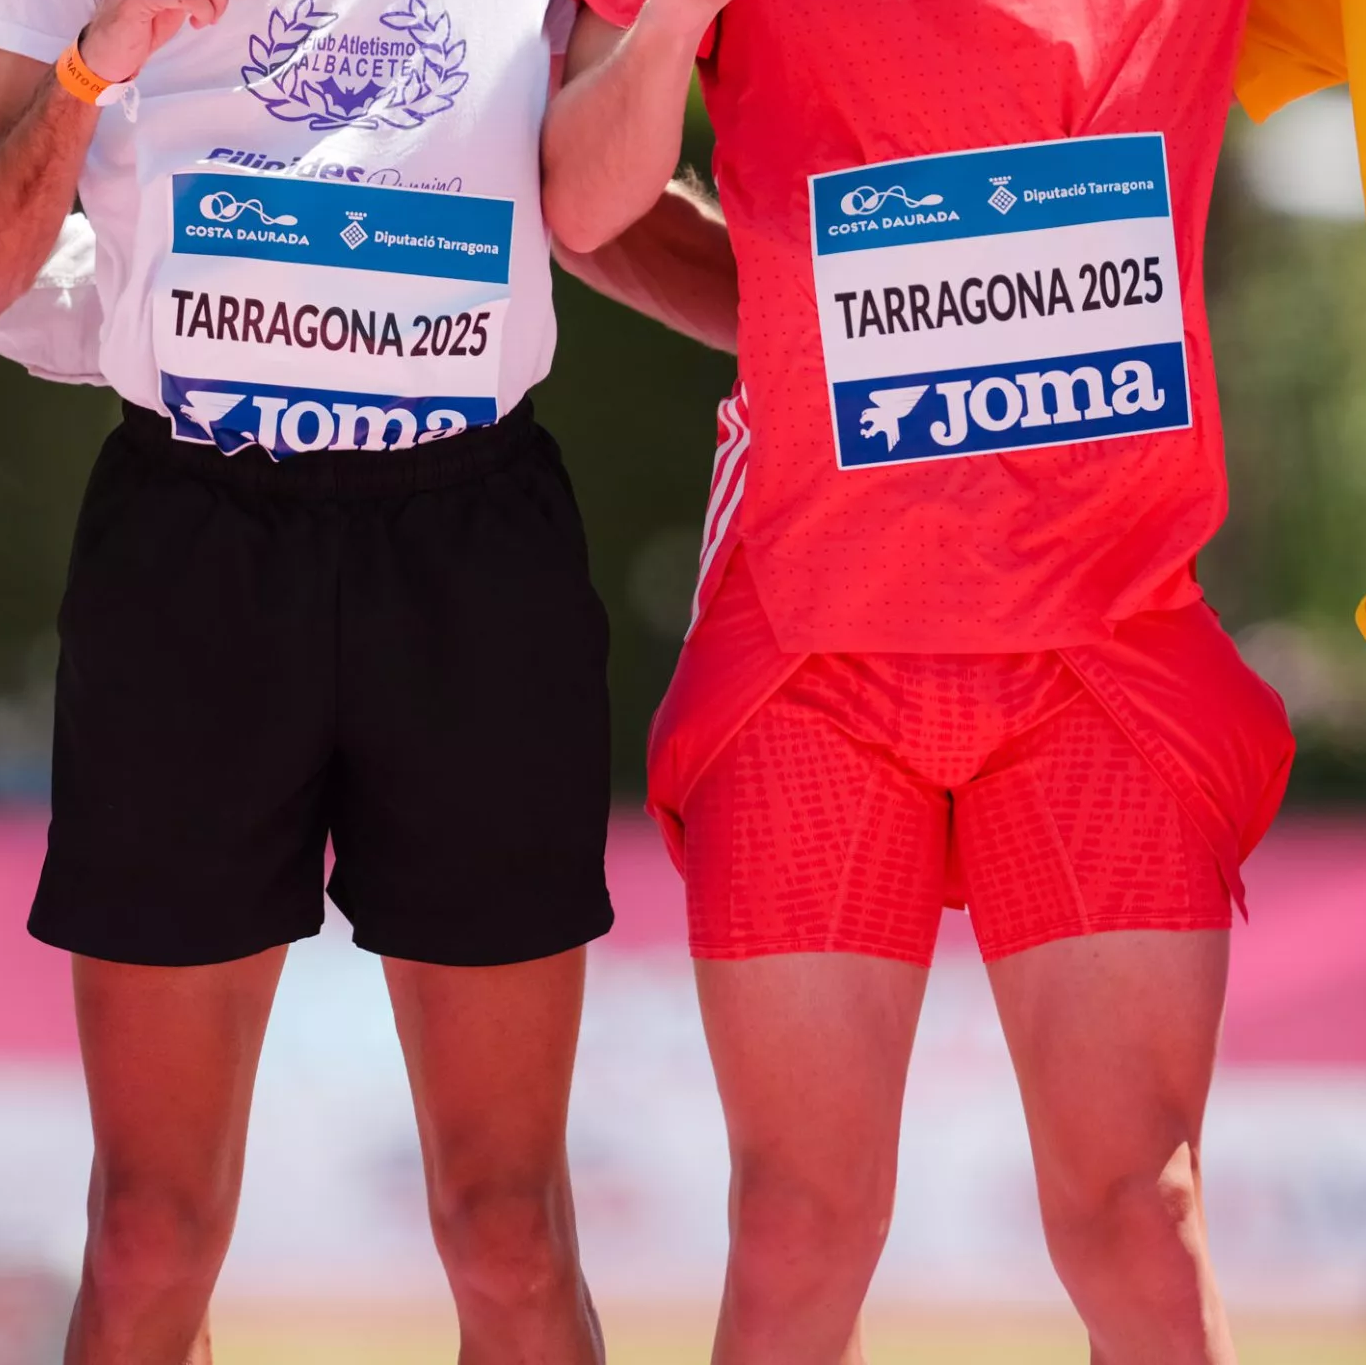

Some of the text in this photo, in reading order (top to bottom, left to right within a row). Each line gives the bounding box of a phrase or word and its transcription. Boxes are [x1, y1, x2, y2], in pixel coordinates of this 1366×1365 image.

[337, 33, 416, 56] Atletismo
[296, 53, 413, 78] ALBACETE
[1023, 179, 1155, 204] Diputació Tarragona
[185, 224, 310, 246] COSTA DAURADA
[828, 210, 960, 237] COSTA DAURADA
[374, 230, 499, 257] Diputació Tarragona
[835, 256, 1164, 339] TARRAGONA 2025
[171, 288, 491, 357] TARRAGONA 2025
